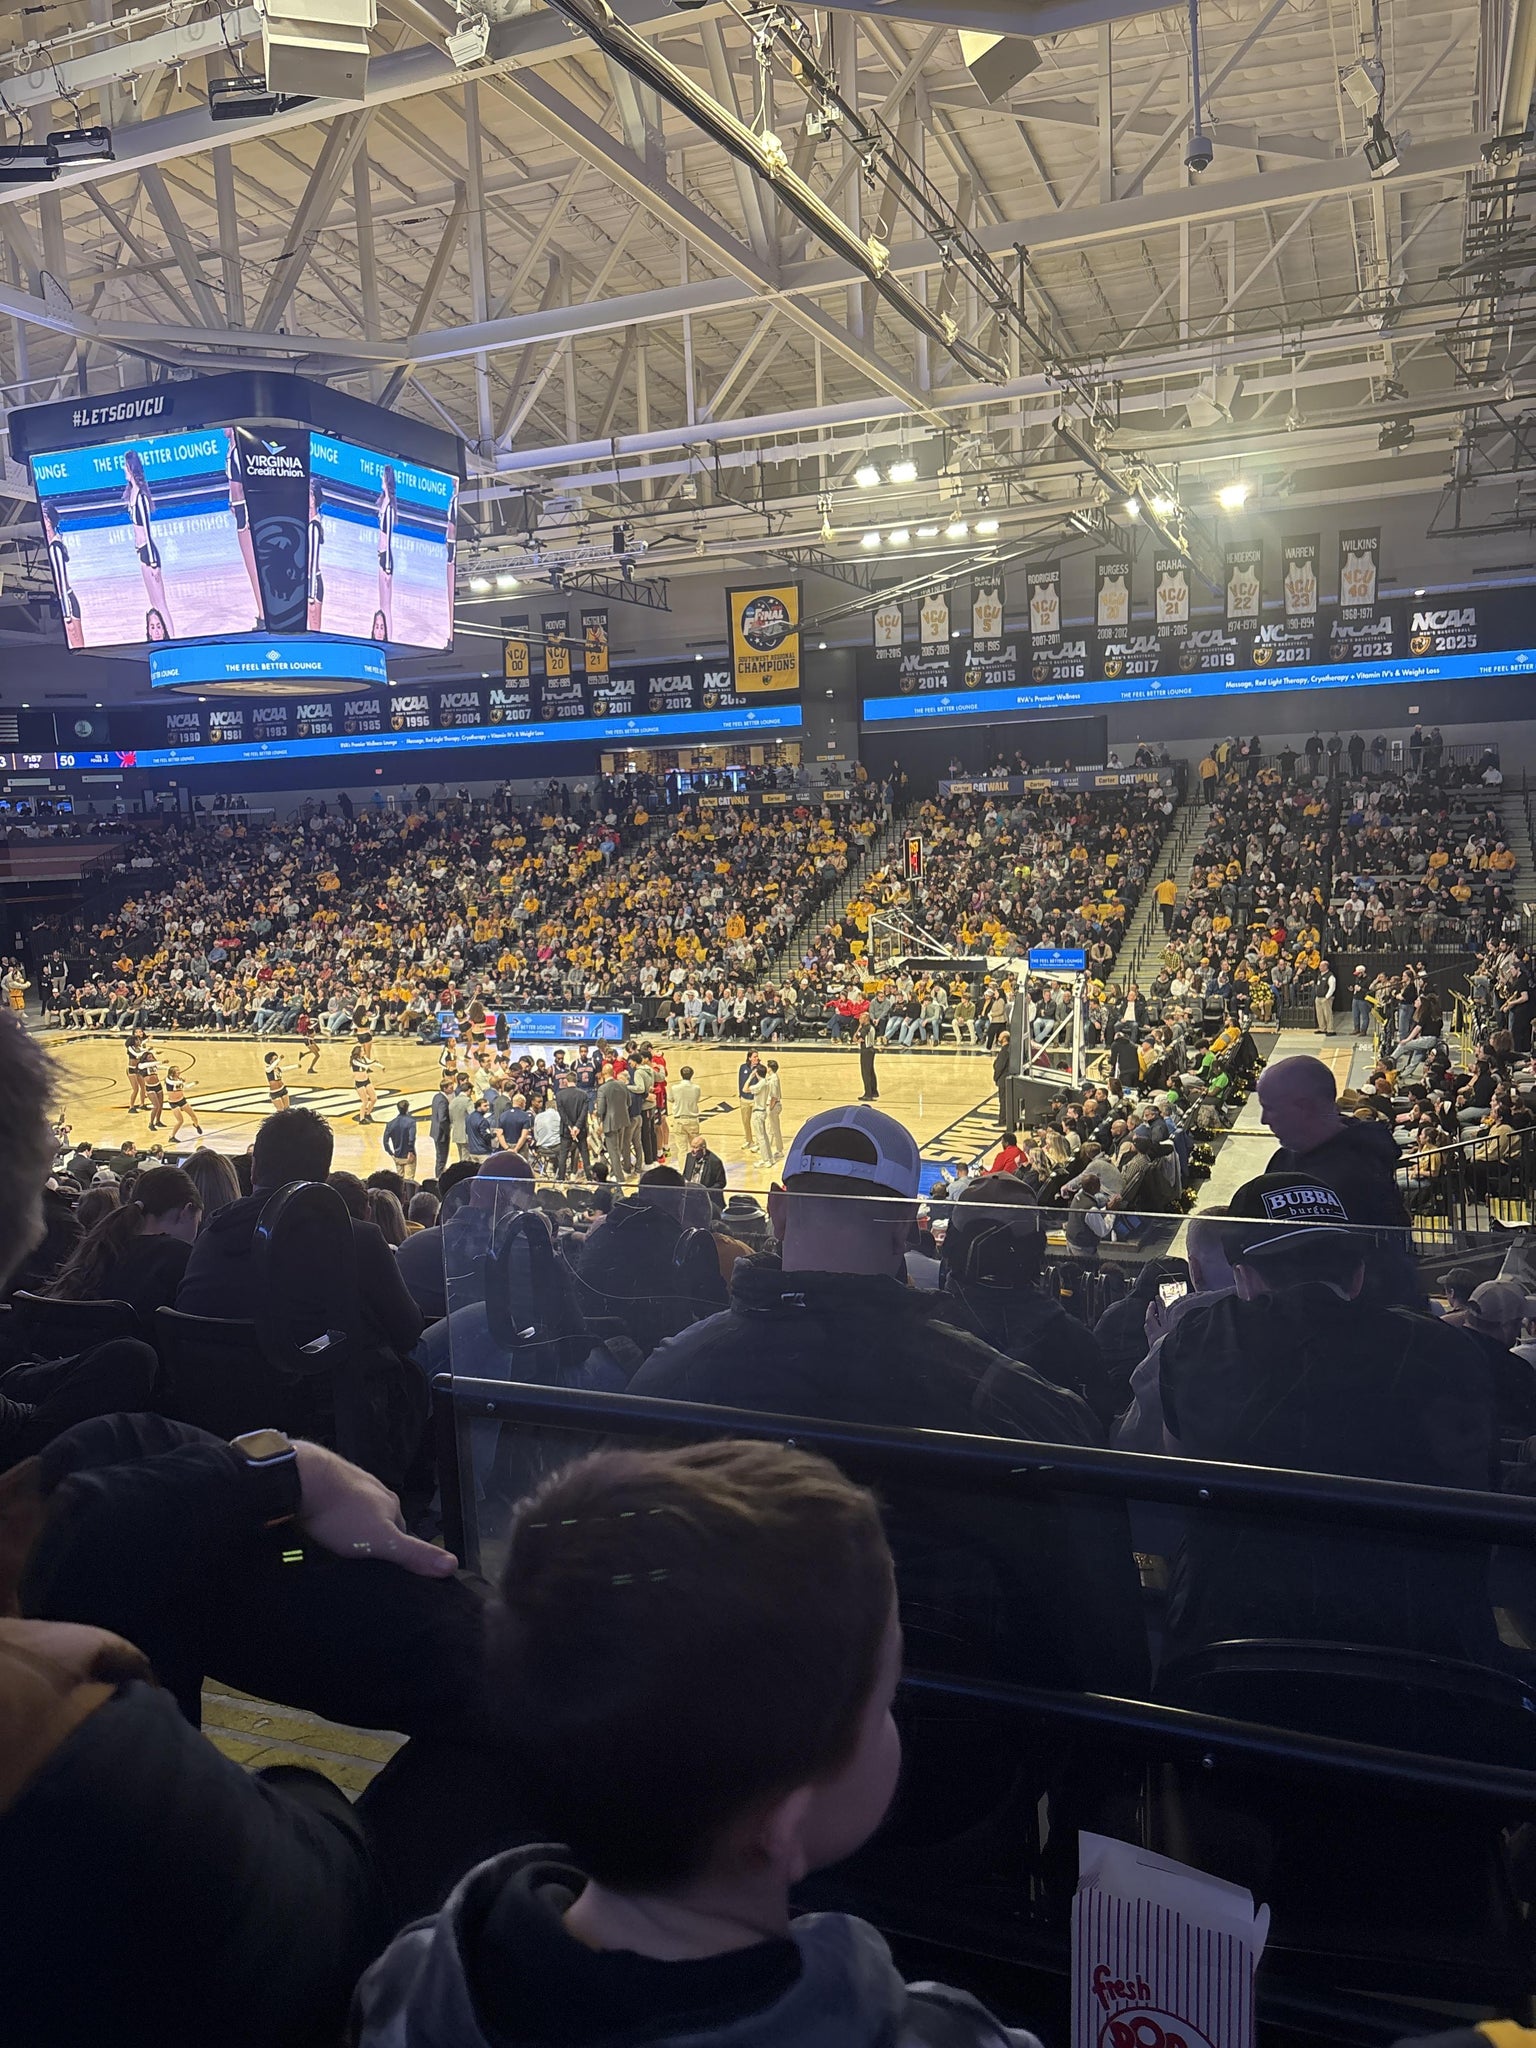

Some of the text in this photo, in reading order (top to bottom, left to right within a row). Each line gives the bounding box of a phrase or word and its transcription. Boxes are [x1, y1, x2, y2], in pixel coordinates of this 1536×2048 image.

[72, 396, 164, 427] #LETSGOVCU
[93, 458, 111, 473] THE
[174, 439, 219, 462] LOUNGE
[246, 455, 302, 468] VIRGINIA
[247, 467, 277, 476] Credit
[360, 458, 373, 476] THE
[418, 477, 447, 496] LOUNGE
[1342, 538, 1377, 551] WILKINS
[1227, 550, 1260, 564] HENDERSON
[1285, 546, 1314, 559] WARREN
[1099, 564, 1128, 575] BURGESS
[1157, 559, 1187, 571] GRAHA
[1028, 572, 1059, 585] RODRIGUEZ
[1344, 570, 1374, 584] VCU
[1230, 583, 1257, 597] VCU
[1286, 579, 1314, 594] VCU
[1348, 584, 1368, 597] 40
[1159, 588, 1186, 602] VCU
[1292, 594, 1309, 607] 23
[1033, 600, 1057, 613] VCU
[1166, 602, 1178, 615] 21
[1234, 597, 1251, 610] 22
[923, 611, 947, 624] VCU
[975, 605, 1000, 619] VCU
[1107, 606, 1119, 619] 20
[545, 620, 566, 629] HOOVER
[877, 615, 899, 627] VCU
[983, 619, 991, 632] 5
[1040, 614, 1050, 625] 12
[1288, 617, 1315, 630] 990-1994
[1411, 608, 1477, 631] NCAA
[885, 628, 891, 639] 2
[931, 624, 938, 635] 3
[1436, 634, 1477, 650] 2025
[507, 649, 526, 660] VCU
[548, 648, 566, 658] VCU
[1277, 648, 1310, 662] 2021
[1353, 643, 1392, 657] 2023
[512, 661, 523, 671] 00
[552, 659, 563, 669] 20
[591, 656, 600, 665] 21
[738, 659, 795, 673] CHAMPIONS
[1201, 653, 1234, 667] 2019
[242, 663, 259, 671] FEEL
[1053, 665, 1084, 679] 2016
[1126, 660, 1158, 674] 2017
[703, 672, 730, 688] NC
[919, 676, 948, 690] 2014
[985, 670, 1015, 684] 2015
[1268, 678, 1282, 687] Light
[1311, 673, 1349, 684] Cryotherapy
[1356, 672, 1380, 680] Vitamin
[1402, 668, 1425, 678] Weight
[649, 675, 693, 693] NCAA
[440, 692, 480, 708] NCAA
[666, 698, 692, 709] 2012
[1056, 693, 1080, 701] Wellness
[345, 700, 380, 715] NCAA
[391, 696, 429, 712] NCAA
[609, 702, 631, 714] 2011
[253, 708, 287, 722] NCAA
[297, 704, 332, 719] NCAA
[506, 709, 531, 720] 2007
[557, 705, 584, 717] 2009
[167, 714, 199, 728] NCAA
[210, 711, 243, 725] NCAA
[407, 716, 429, 727] 1996
[456, 713, 480, 724] 2004
[266, 727, 287, 737] 1983
[311, 723, 332, 734] 1984
[359, 720, 380, 731] 1985
[180, 732, 200, 743] 1980
[224, 730, 241, 740] 1981
[60, 756, 75, 766] 50
[1120, 773, 1159, 785] CATWALK
[973, 782, 1009, 792] CATWALK
[1269, 1190, 1339, 1210] BUBBA
[1290, 1206, 1330, 1215] burger
[1093, 1965, 1150, 2011] fresh
